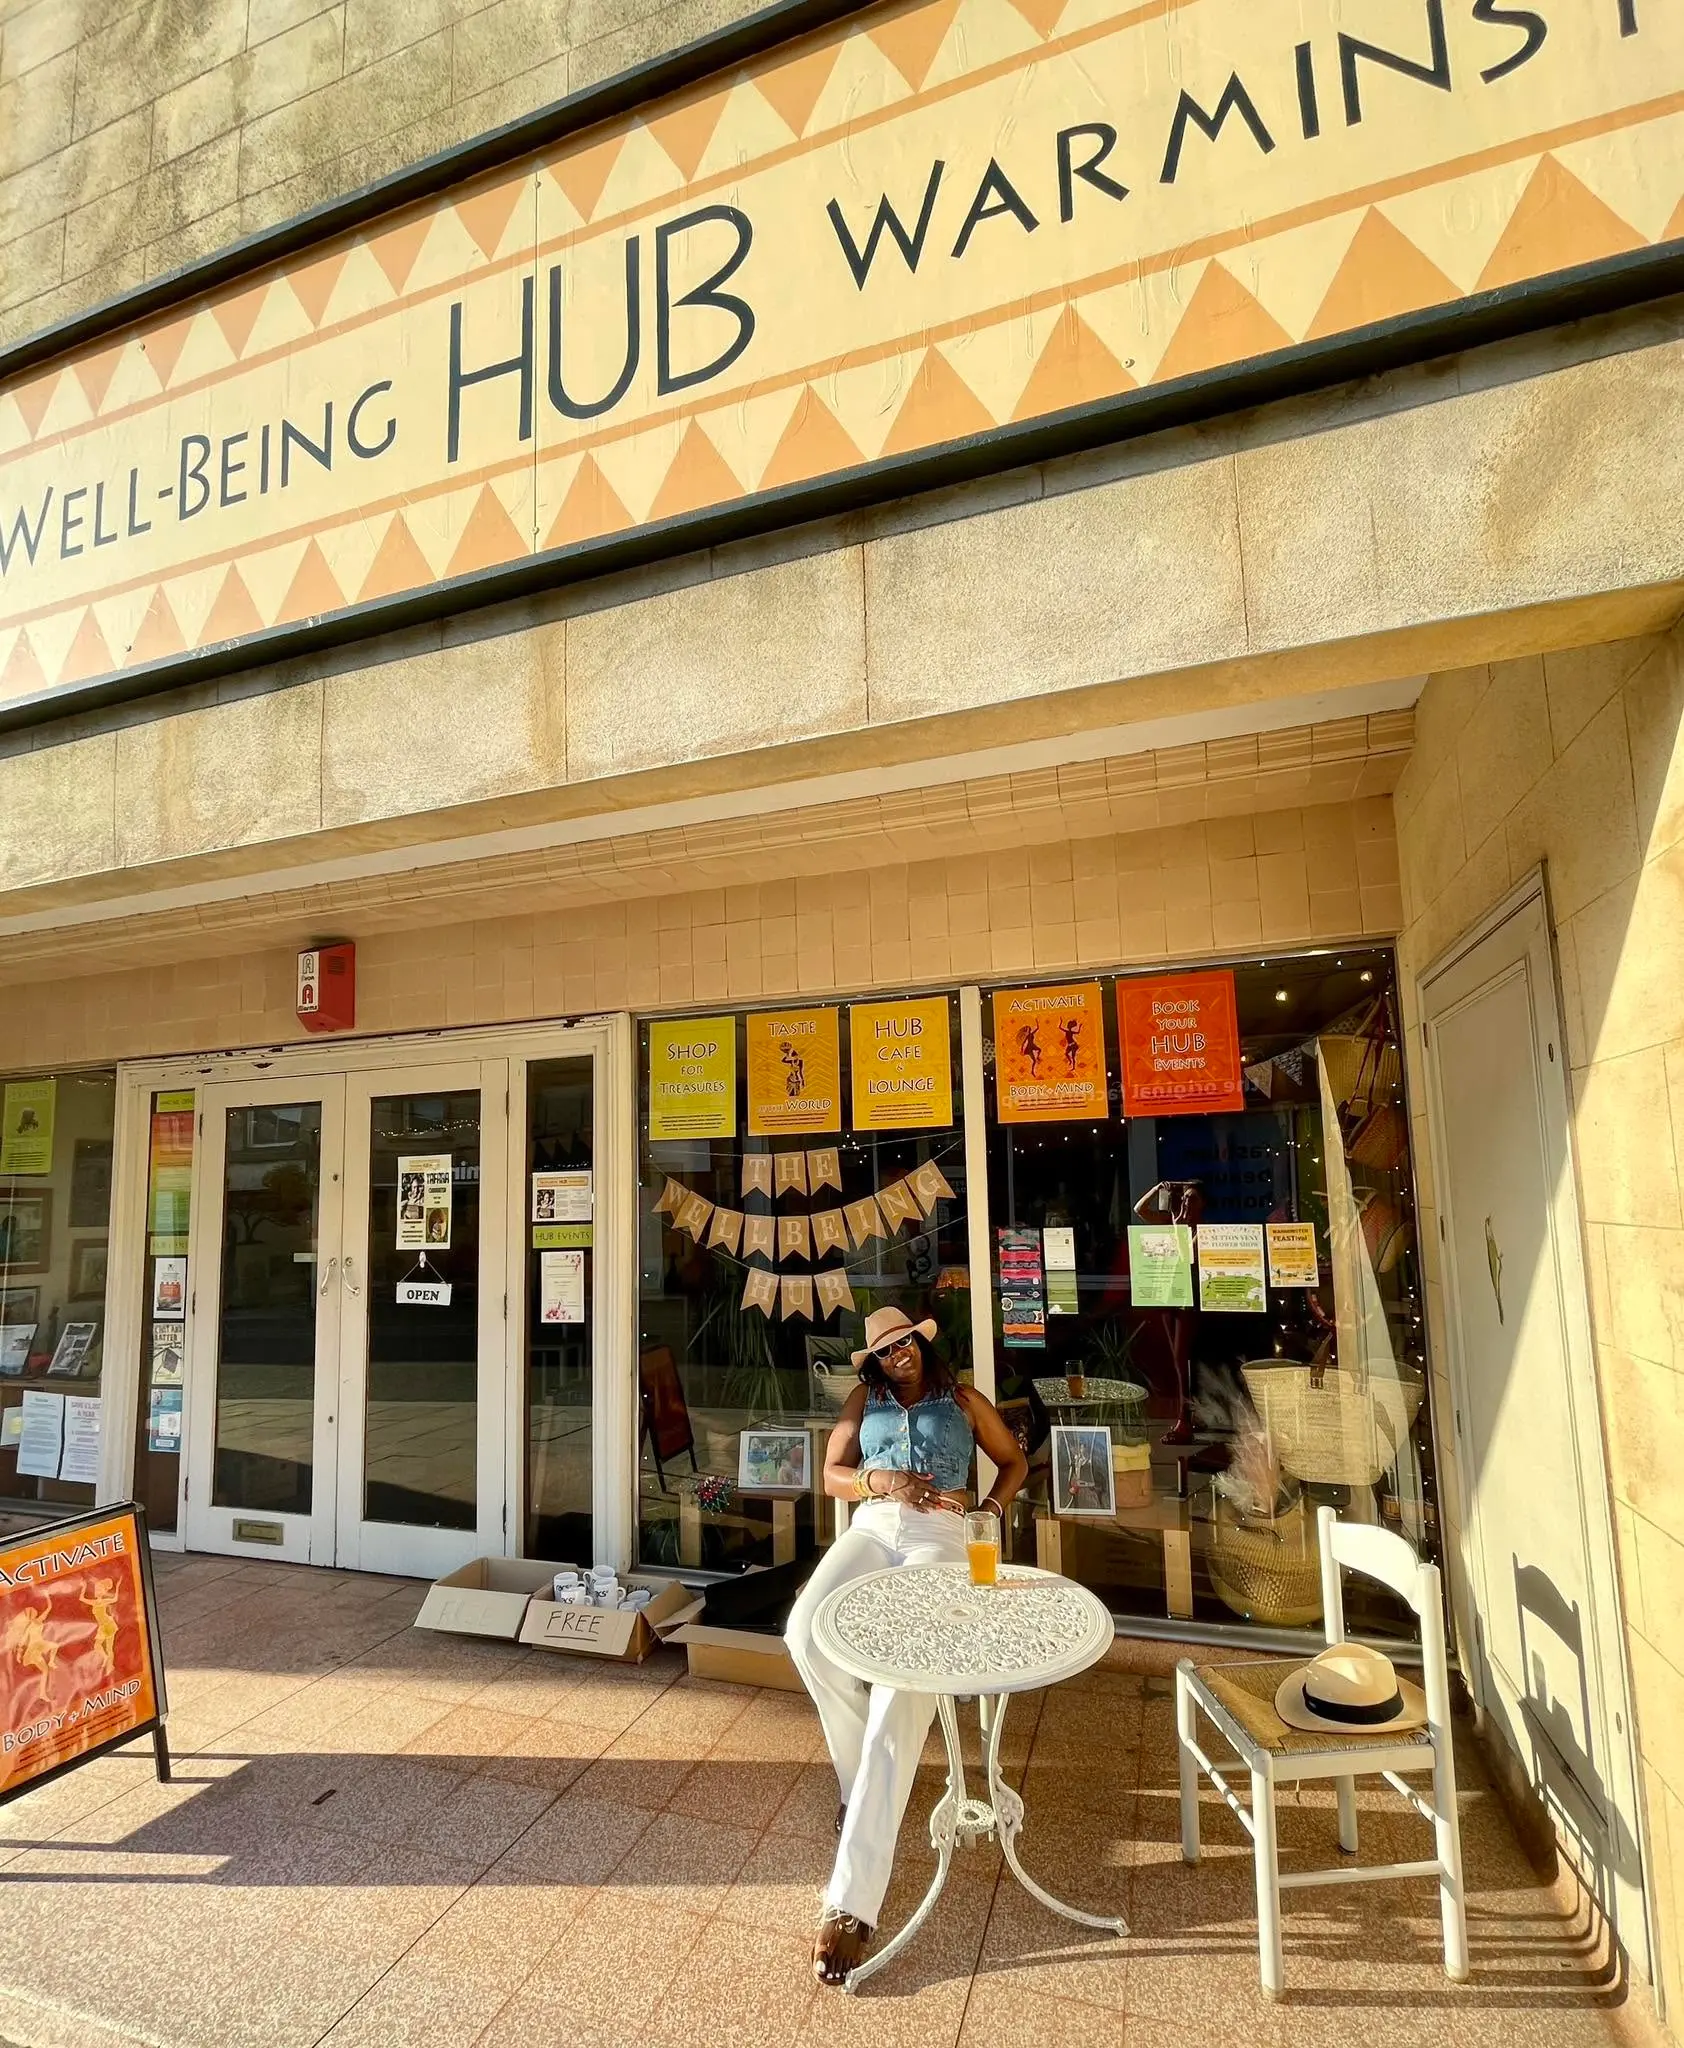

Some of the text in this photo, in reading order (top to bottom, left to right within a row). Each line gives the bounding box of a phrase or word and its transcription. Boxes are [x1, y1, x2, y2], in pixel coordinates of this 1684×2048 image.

[0, 0, 1639, 577] WELL-BEING HUB WARMINS
[1009, 994, 1084, 1013] ACTIVATE
[1152, 1000, 1200, 1015] BOOK
[768, 1021, 816, 1036] TASTE
[875, 1018, 923, 1039] HUB
[1157, 1018, 1196, 1031] YOUR
[667, 1043, 717, 1060] SHOP
[1151, 1033, 1206, 1054] HUB
[878, 1046, 921, 1060] CAFE
[681, 1065, 703, 1076] FOR
[1154, 1057, 1206, 1072] EVENTS
[659, 1081, 727, 1095] TREASURES
[868, 1078, 934, 1094] LOUNGE
[1010, 1085, 1045, 1097] BODY
[1055, 1082, 1093, 1094] MIND
[785, 1099, 831, 1111] WORLD
[749, 1152, 832, 1183] THE
[667, 1169, 942, 1246] WELLBEING
[535, 1231, 590, 1240] HUB EVENTS
[406, 1290, 440, 1301] OPEN
[748, 1274, 844, 1305] HUB
[0, 1532, 124, 1587] ACTIVATE
[546, 1610, 605, 1635] FREE
[3, 1712, 65, 1752] BODY
[81, 1679, 142, 1717] MIND
